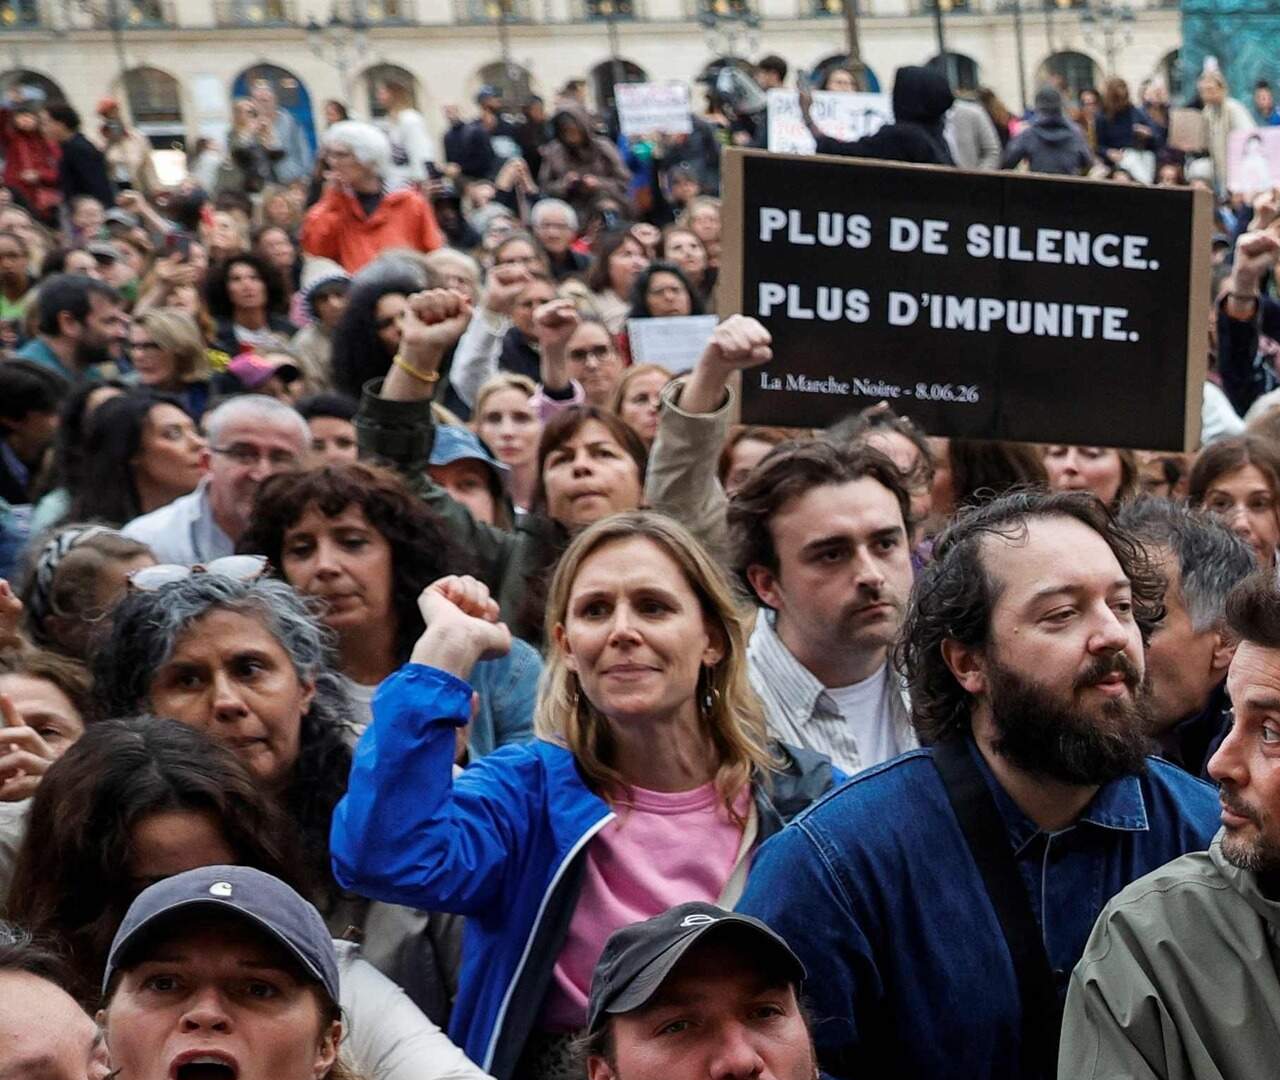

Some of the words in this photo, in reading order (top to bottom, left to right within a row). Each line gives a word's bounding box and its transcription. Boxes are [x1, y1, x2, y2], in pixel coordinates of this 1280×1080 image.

[758, 206, 872, 249] PLUS
[889, 216, 949, 255] DE
[966, 223, 1160, 271] SILENCE.
[758, 282, 871, 324] PLUS
[888, 292, 1140, 342] D'IMPUNITE.
[760, 371, 783, 390] La
[786, 373, 849, 395] Marche
[852, 377, 901, 398] Noire
[914, 382, 980, 403] 8.06.26
